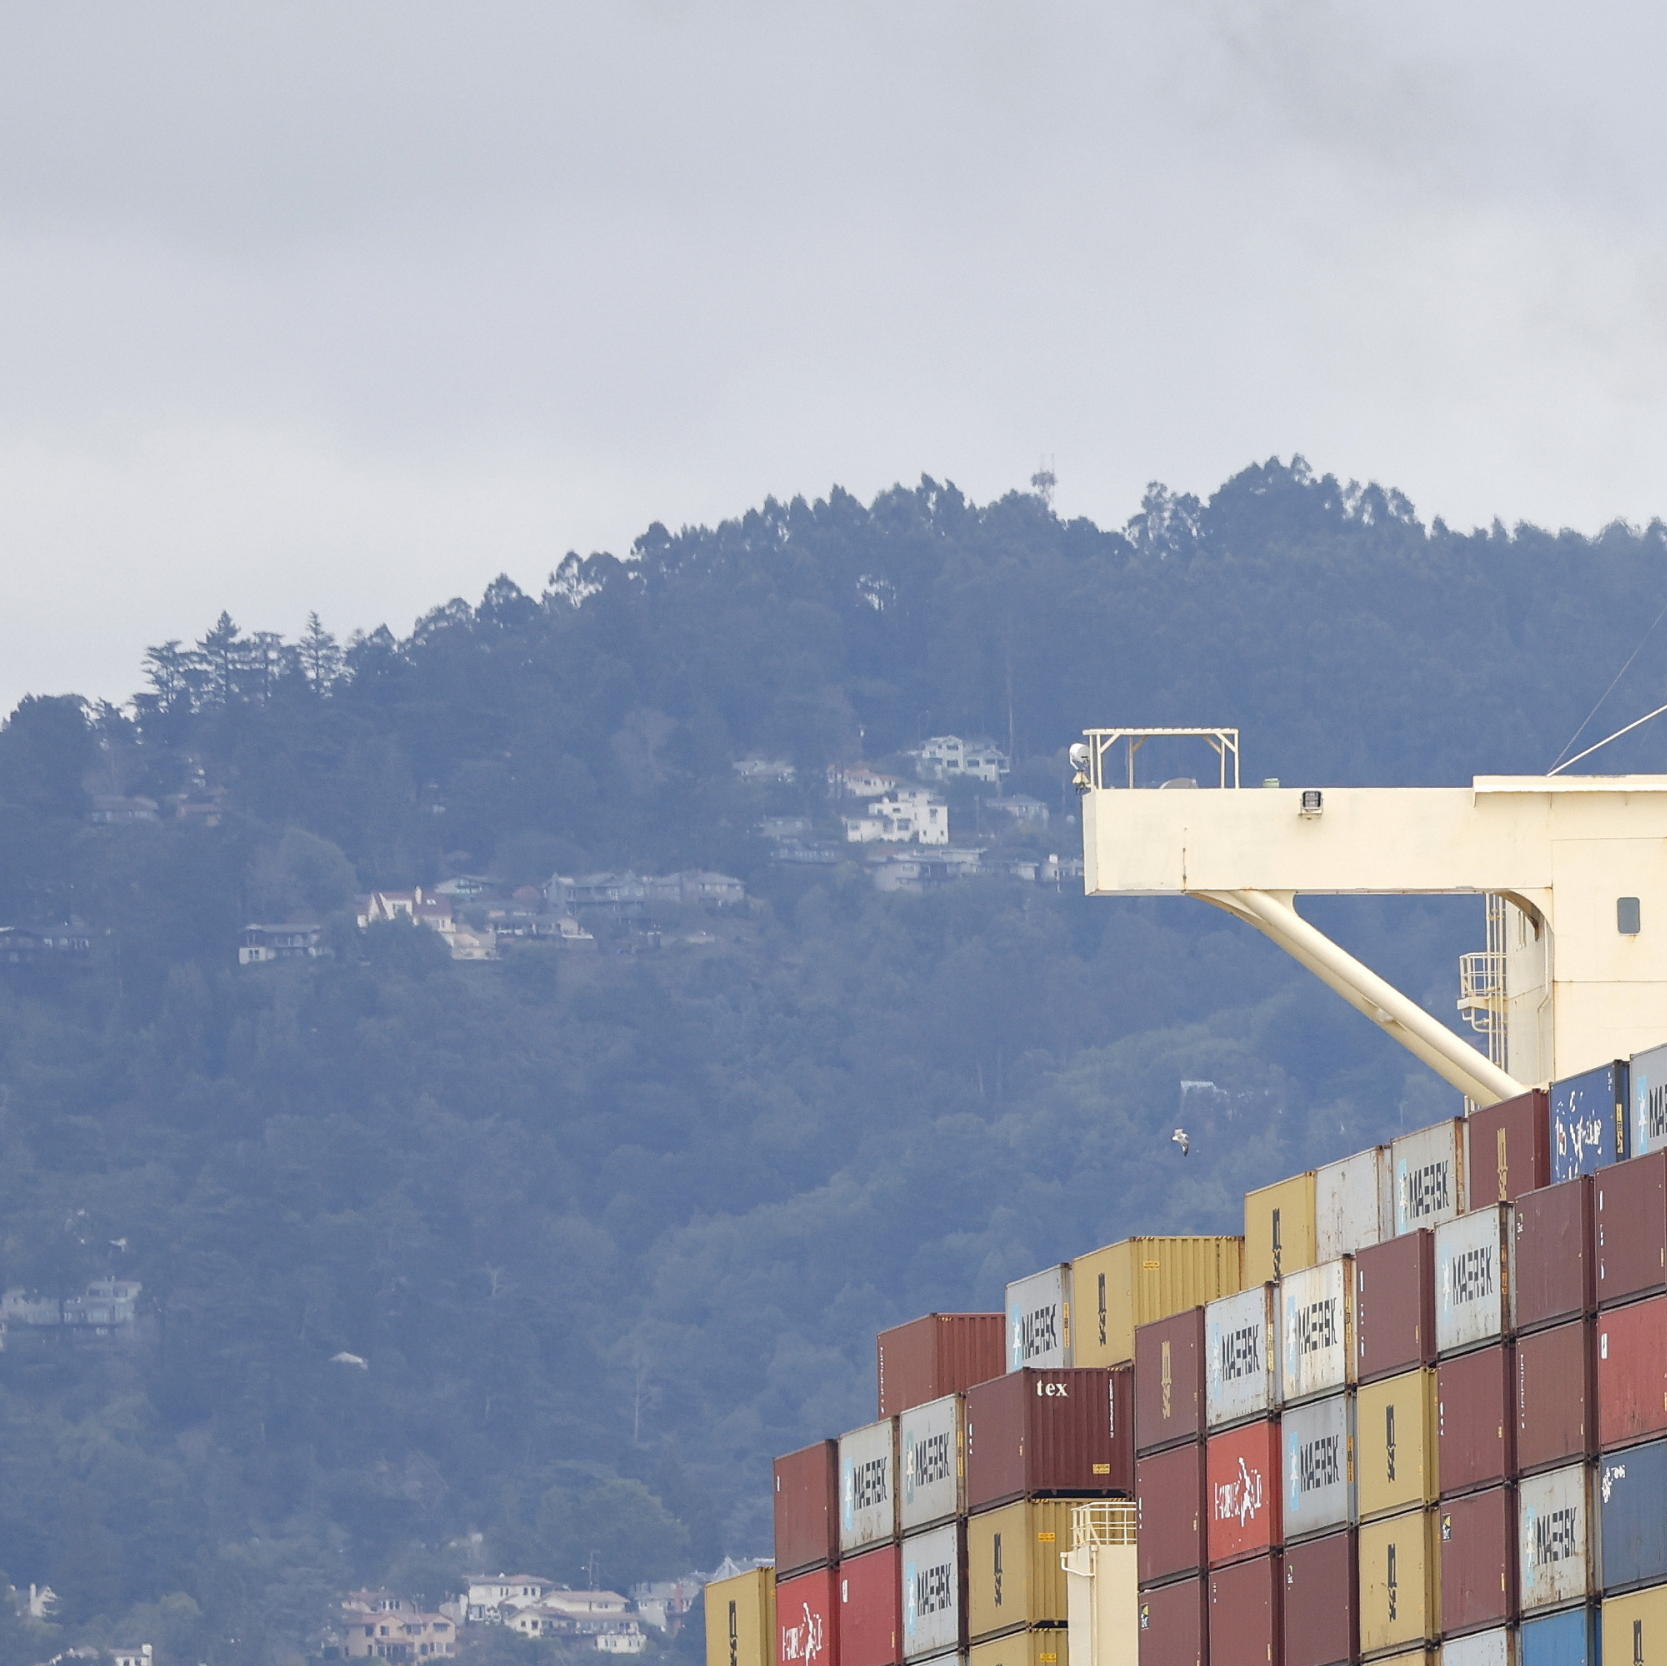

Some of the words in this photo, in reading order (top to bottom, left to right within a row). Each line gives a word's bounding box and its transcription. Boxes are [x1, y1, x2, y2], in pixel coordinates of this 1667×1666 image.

[1410, 1160, 1449, 1217] MAERSK
[1453, 1246, 1492, 1305] MAERSK
[1022, 1304, 1057, 1359] MAERSK
[1223, 1325, 1260, 1381] MAERSK
[1298, 1298, 1337, 1355] MAERSK
[1036, 1379, 1068, 1397] tex
[854, 1457, 887, 1509] MAERSK
[916, 1432, 949, 1486] MAERSK
[1301, 1435, 1339, 1491] MAERSK
[1537, 1507, 1576, 1565] MAERSK
[918, 1563, 951, 1616] MAERSK
